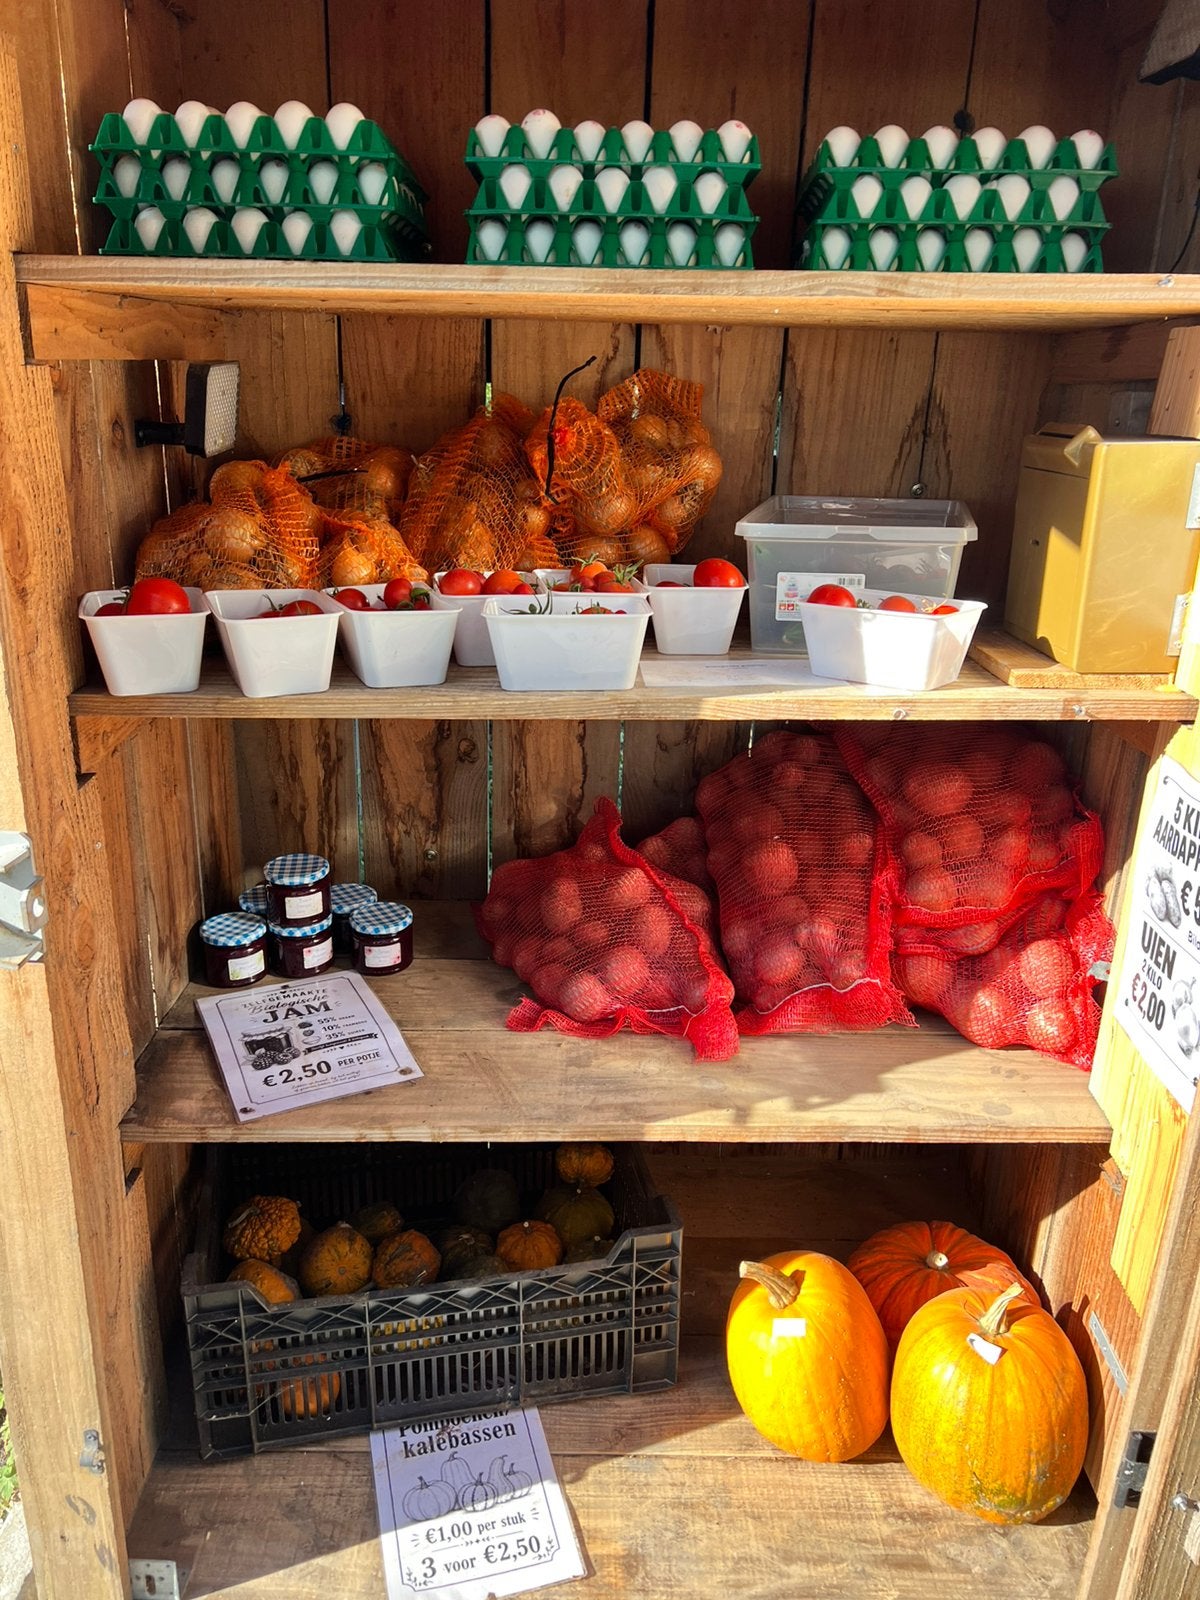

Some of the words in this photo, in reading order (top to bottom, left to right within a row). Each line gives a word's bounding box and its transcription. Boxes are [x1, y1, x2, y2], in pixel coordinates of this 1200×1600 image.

[1174, 797, 1184, 825] 5
[1141, 920, 1177, 980] UIEN
[1141, 959, 1148, 972] 2
[1146, 964, 1163, 990] KILO
[242, 988, 328, 1009] ZELFGEMAAKTE
[248, 994, 328, 1015] Biologische
[1131, 972, 1166, 1031] €2,00
[262, 1001, 333, 1024] JAM
[317, 1016, 337, 1024] 55%
[322, 1023, 341, 1032] 10%
[325, 1031, 345, 1040] 35%
[337, 1057, 355, 1067] PER
[356, 1051, 381, 1063] POTJE
[402, 1422, 517, 1459] kalebassen
[425, 1521, 473, 1545] €1,00
[477, 1519, 497, 1534] per
[500, 1511, 527, 1528] stuk
[421, 1557, 437, 1579] 3
[443, 1556, 477, 1574] voor
[484, 1535, 541, 1564] €2,50
